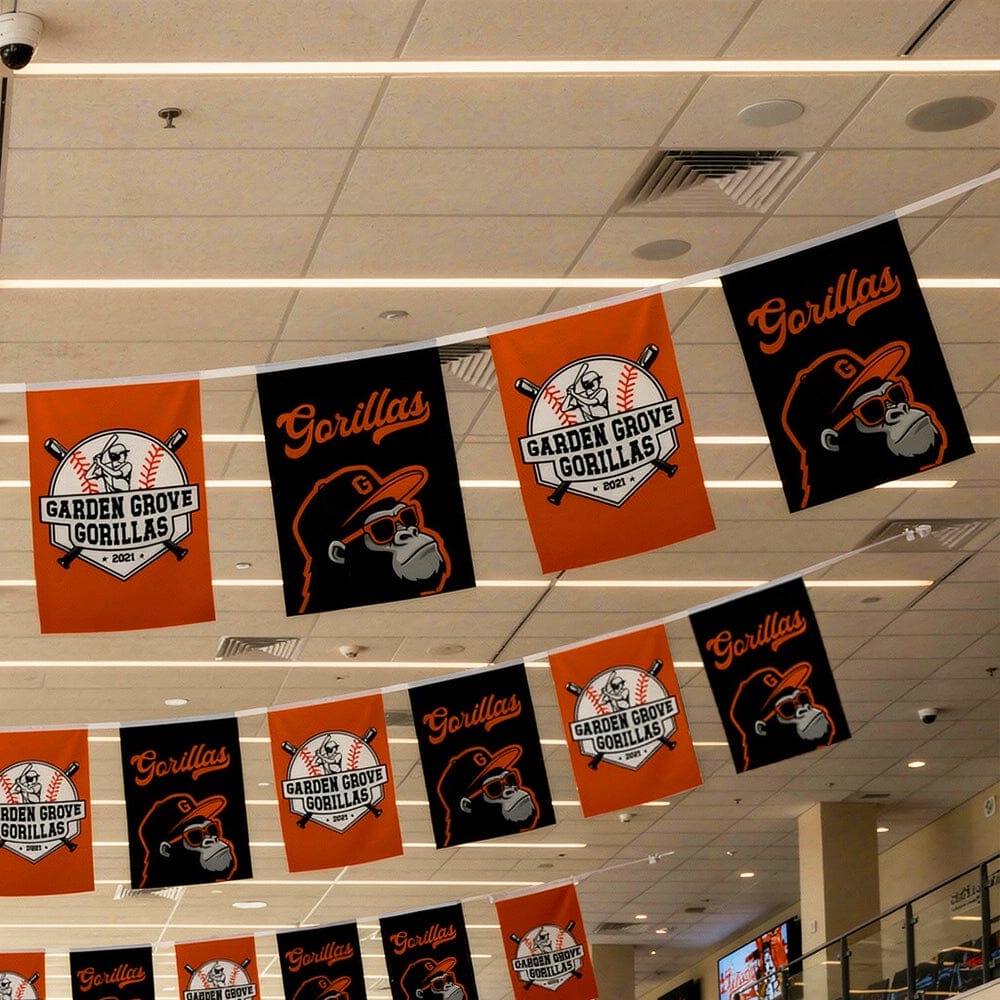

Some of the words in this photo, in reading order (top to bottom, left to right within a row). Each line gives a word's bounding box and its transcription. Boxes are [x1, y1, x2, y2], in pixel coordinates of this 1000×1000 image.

[747, 267, 901, 355] Gorillas
[833, 358, 857, 381] G
[276, 388, 430, 459] Gorillas
[526, 422, 610, 457] GARDEN
[611, 403, 676, 443] GROVE
[560, 435, 656, 477] GORILLAS
[351, 474, 374, 497] G
[601, 477, 627, 492] 2021
[45, 495, 126, 520] GARDEN
[129, 488, 194, 518] GROVE
[74, 516, 169, 547] GORILLAS
[111, 552, 136, 564] 2021
[706, 611, 807, 670] Gorillas
[762, 673, 778, 689] G
[423, 694, 521, 744] Gorillas
[574, 711, 630, 736] GARDEN
[630, 698, 676, 727] GROVE
[596, 720, 662, 750] GORILLAS
[130, 744, 230, 786] Gorillas
[472, 752, 488, 768] G
[285, 775, 340, 795] GARDEN
[341, 767, 385, 791] GROVE
[38, 802, 83, 822] GROVE
[176, 799, 192, 814] G
[306, 787, 370, 812] GORILLAS
[1, 820, 66, 840] GORILLAS
[390, 925, 456, 955] Gorillas
[285, 943, 353, 972] Gorillas
[529, 960, 573, 979] GORILLAS
[77, 964, 145, 992] Gorillas
